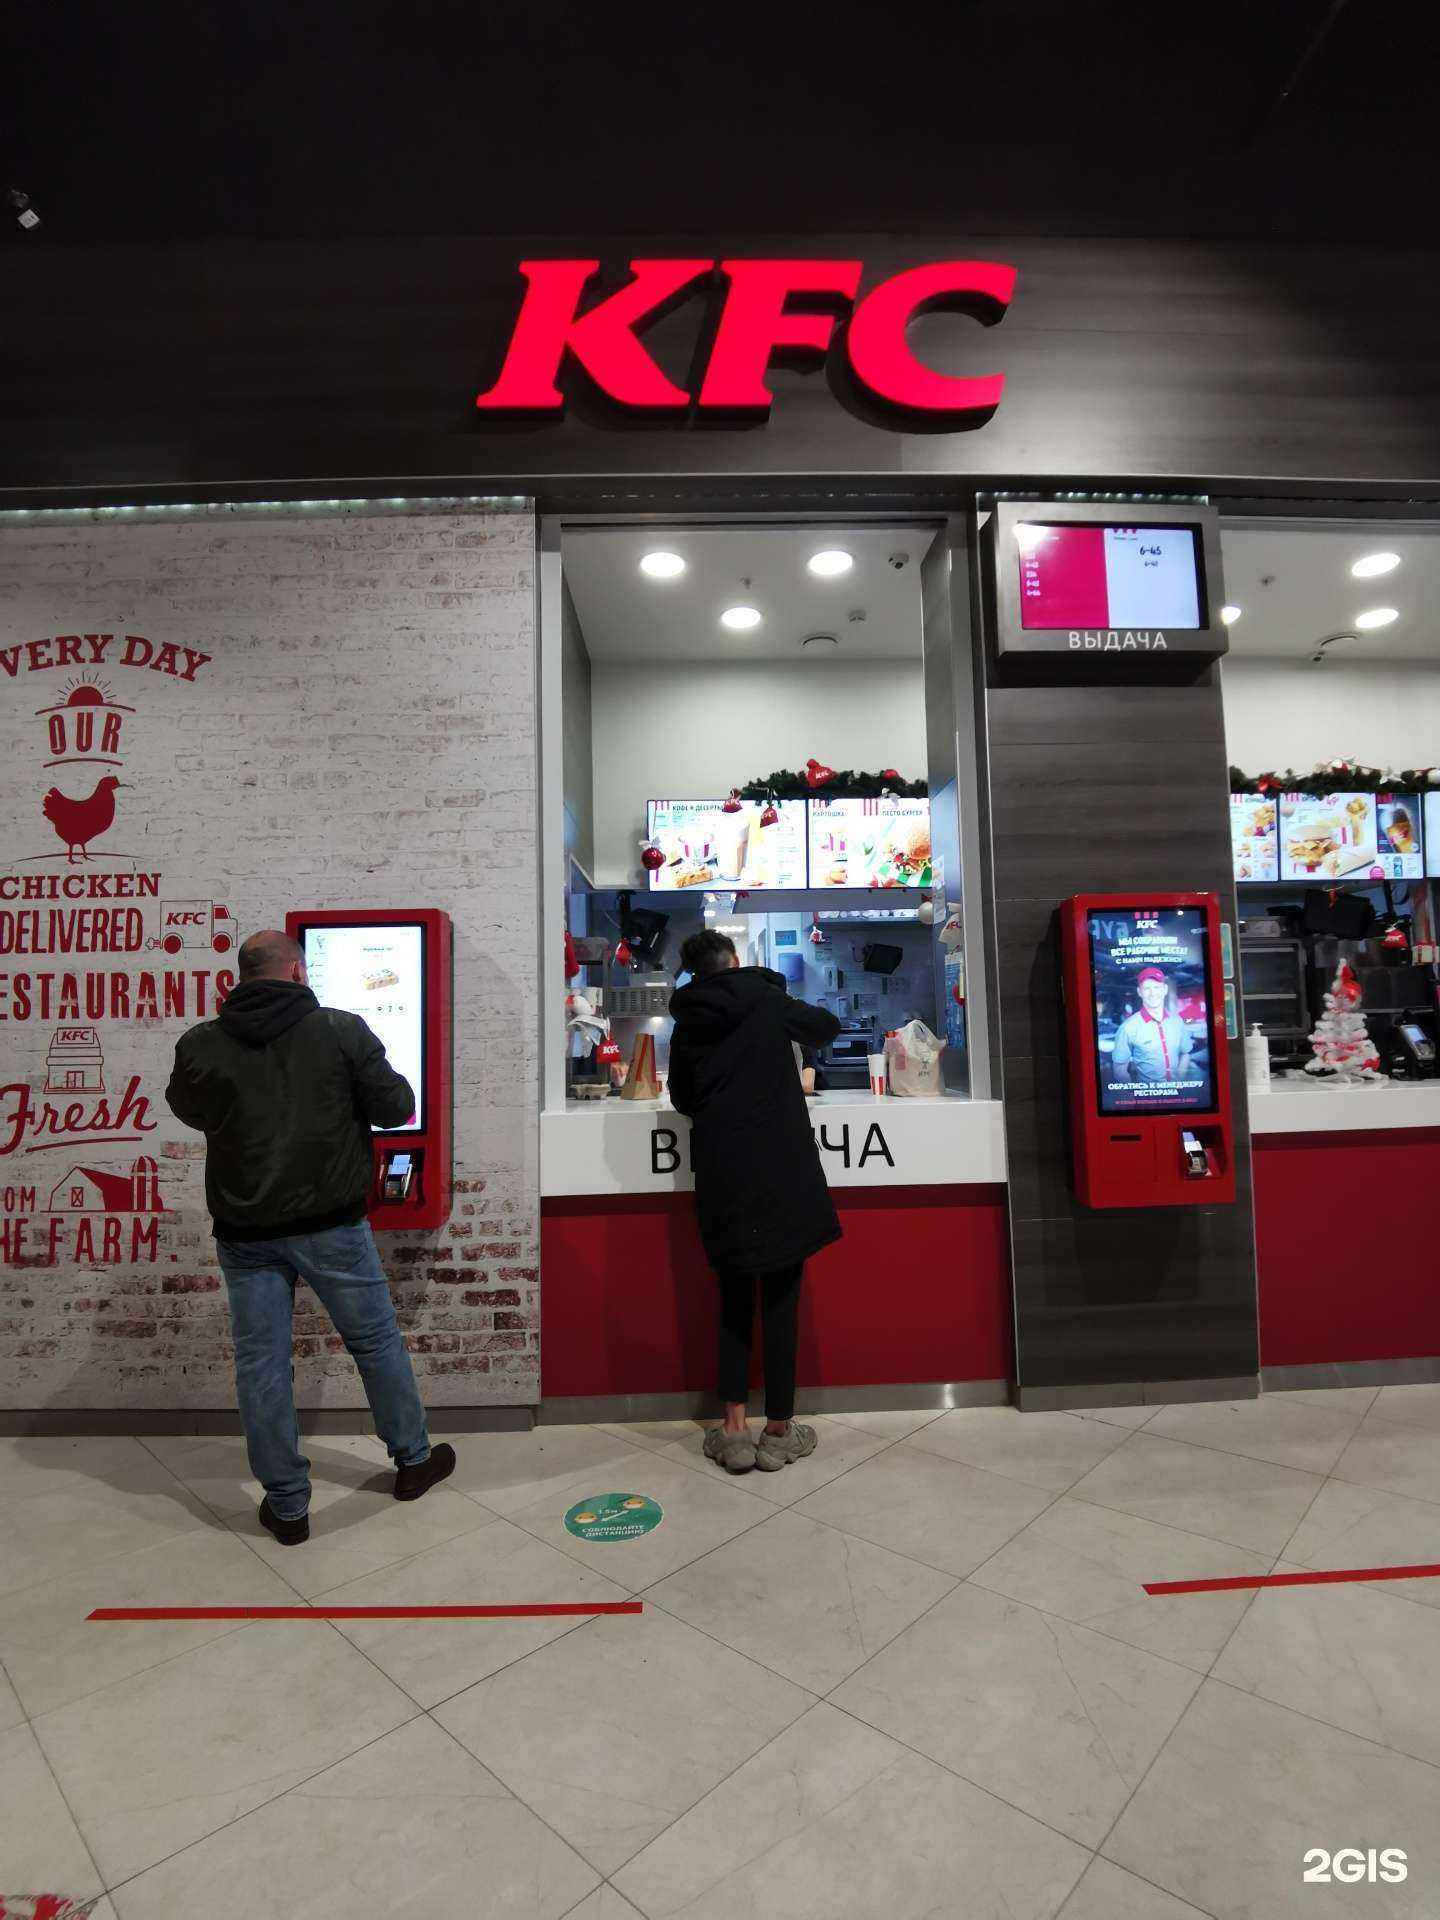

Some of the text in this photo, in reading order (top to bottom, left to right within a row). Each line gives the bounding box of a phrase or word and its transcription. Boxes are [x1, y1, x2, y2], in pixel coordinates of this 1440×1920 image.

[476, 259, 1018, 412] KFC
[120, 635, 212, 682] DAY
[1068, 631, 1168, 651] ВЫДАЧА
[48, 711, 122, 755] OUR
[0, 873, 161, 900] CHICKEN
[0, 908, 143, 953] DELIVERED
[165, 912, 206, 925] KFC
[61, 1030, 91, 1041] KFC
[0, 1075, 158, 1156] Fresh
[48, 1217, 178, 1264] FARM.
